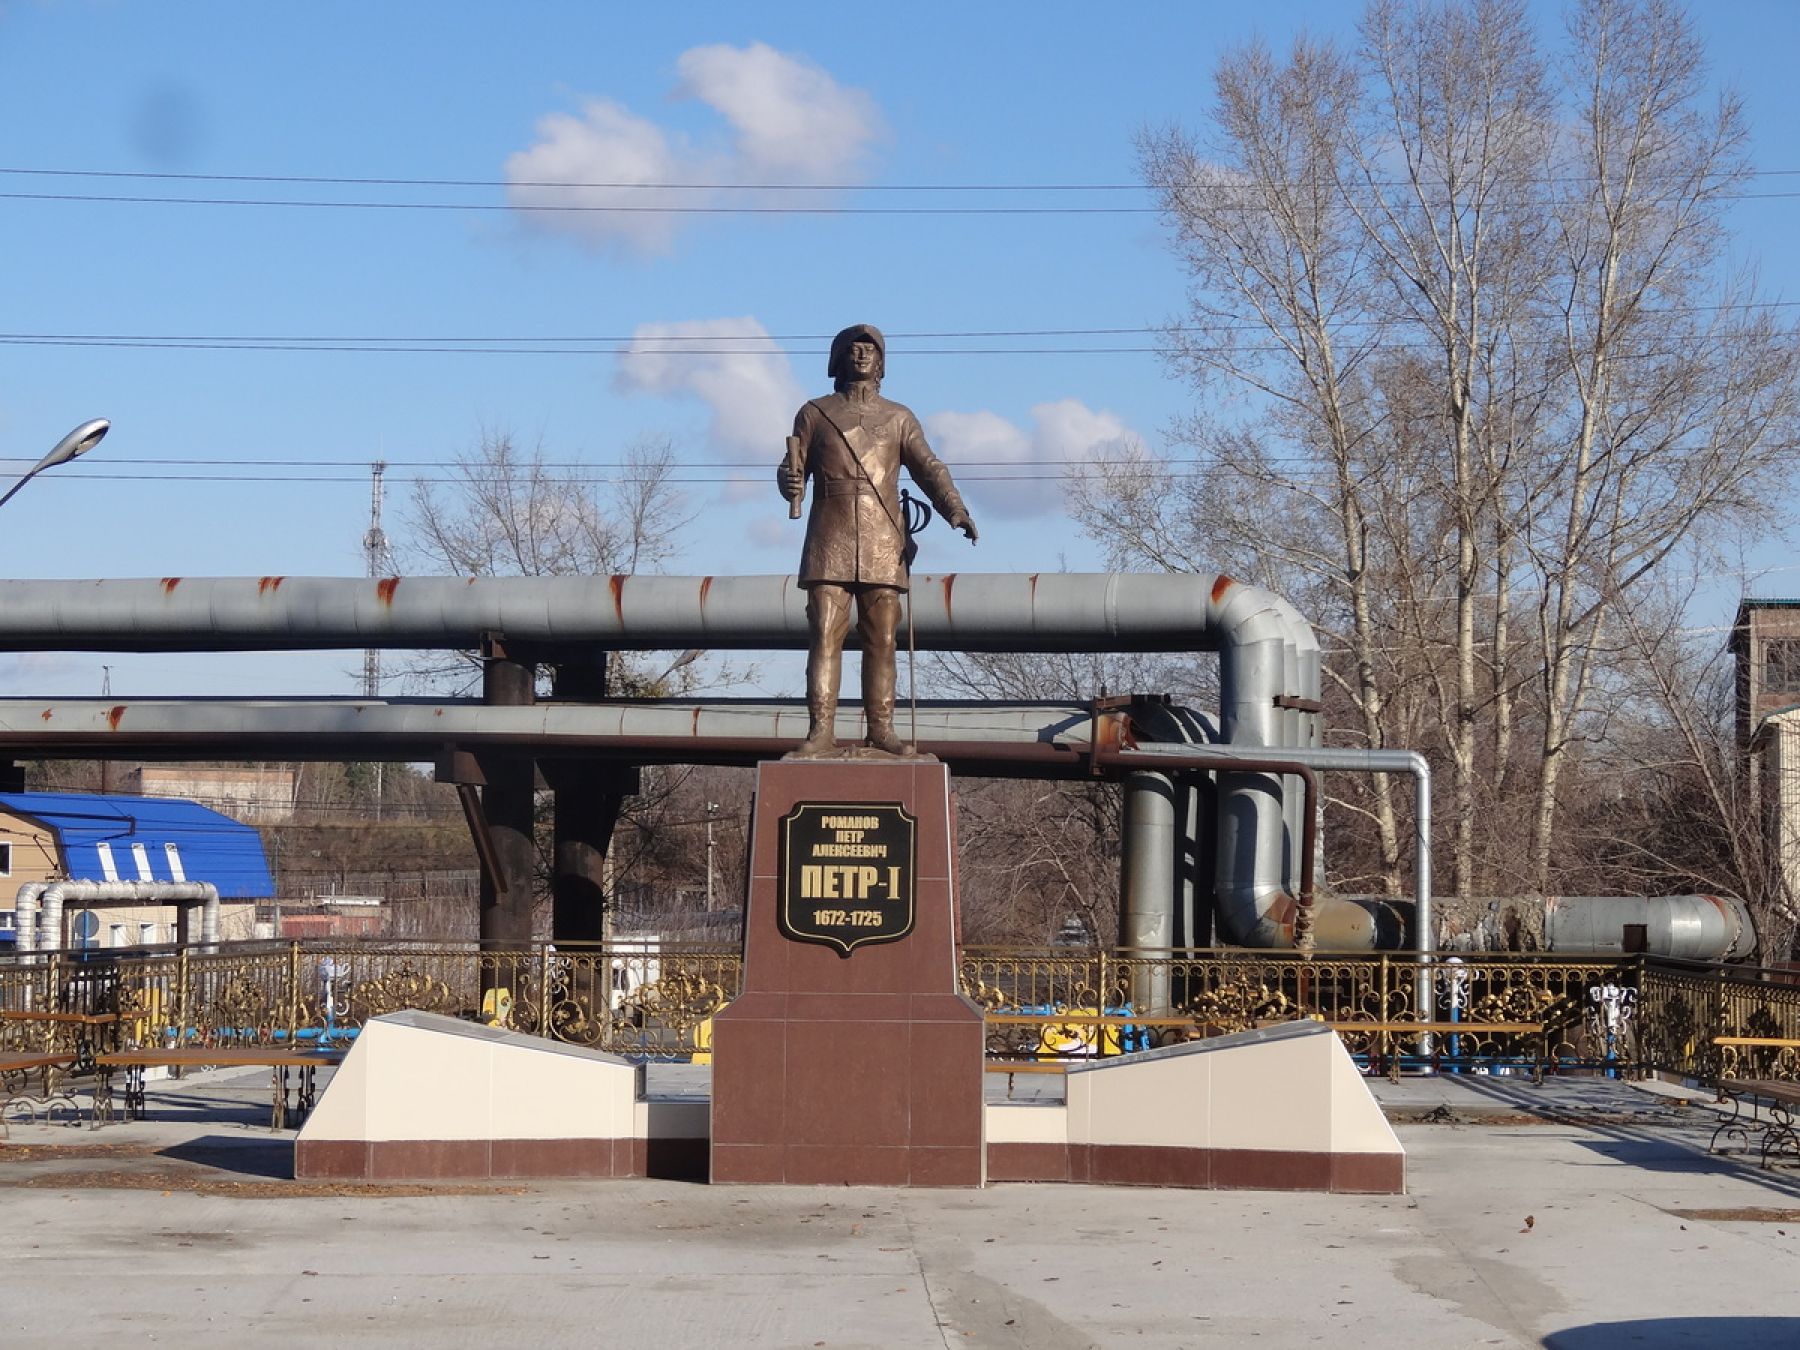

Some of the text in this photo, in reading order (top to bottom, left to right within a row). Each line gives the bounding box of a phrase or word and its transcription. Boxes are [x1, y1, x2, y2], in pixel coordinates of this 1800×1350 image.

[821, 815, 880, 829] РОМАНОВ
[835, 830, 865, 843] ПЕТР
[812, 843, 888, 858] АЛЕКСЕЕВИЧ
[813, 909, 883, 926] 1672-1725
